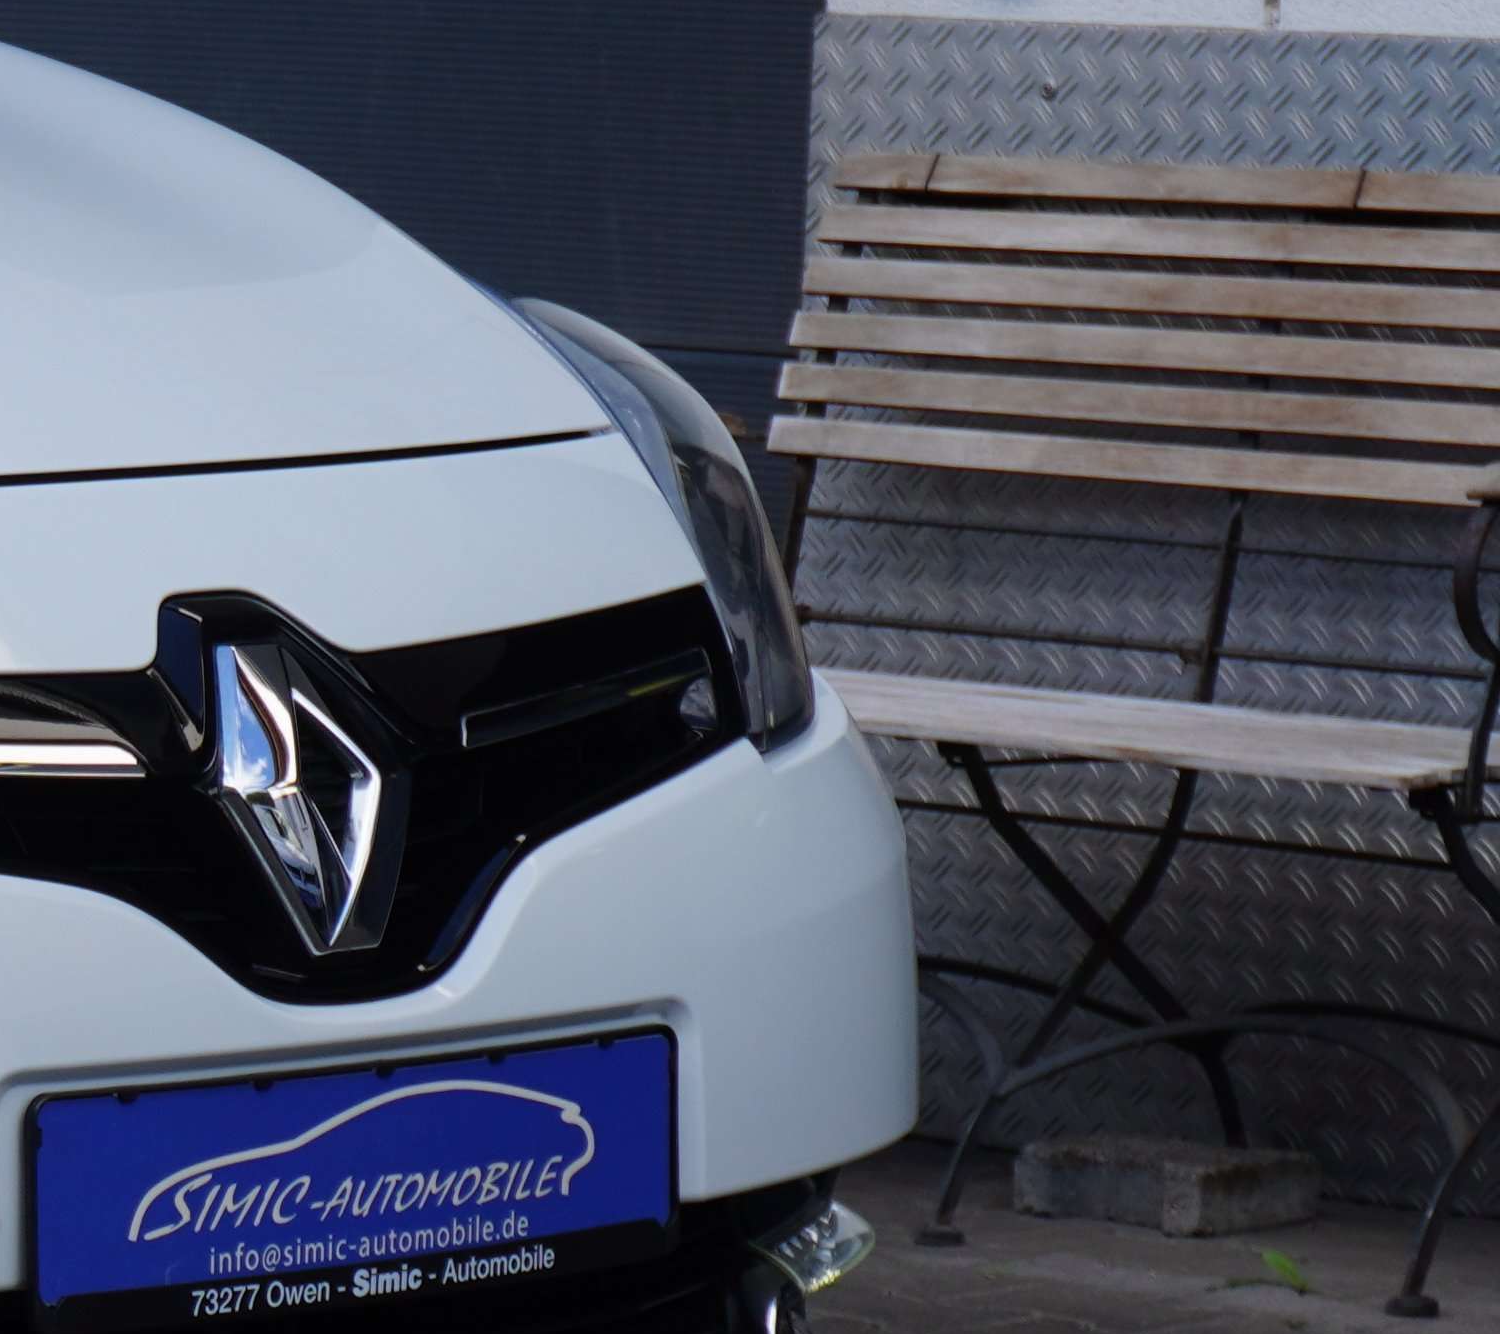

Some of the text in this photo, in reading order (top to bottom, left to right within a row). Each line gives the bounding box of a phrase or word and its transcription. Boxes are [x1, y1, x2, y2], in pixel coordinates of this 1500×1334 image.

[143, 1155, 563, 1241] SIMIC-AUTOMOBILE
[191, 1283, 260, 1317] 73277
[266, 1280, 330, 1308] Owen
[352, 1263, 423, 1298] Simic
[442, 1243, 555, 1285] Automobile
[209, 1210, 529, 1276] info@simic-automobile.de
